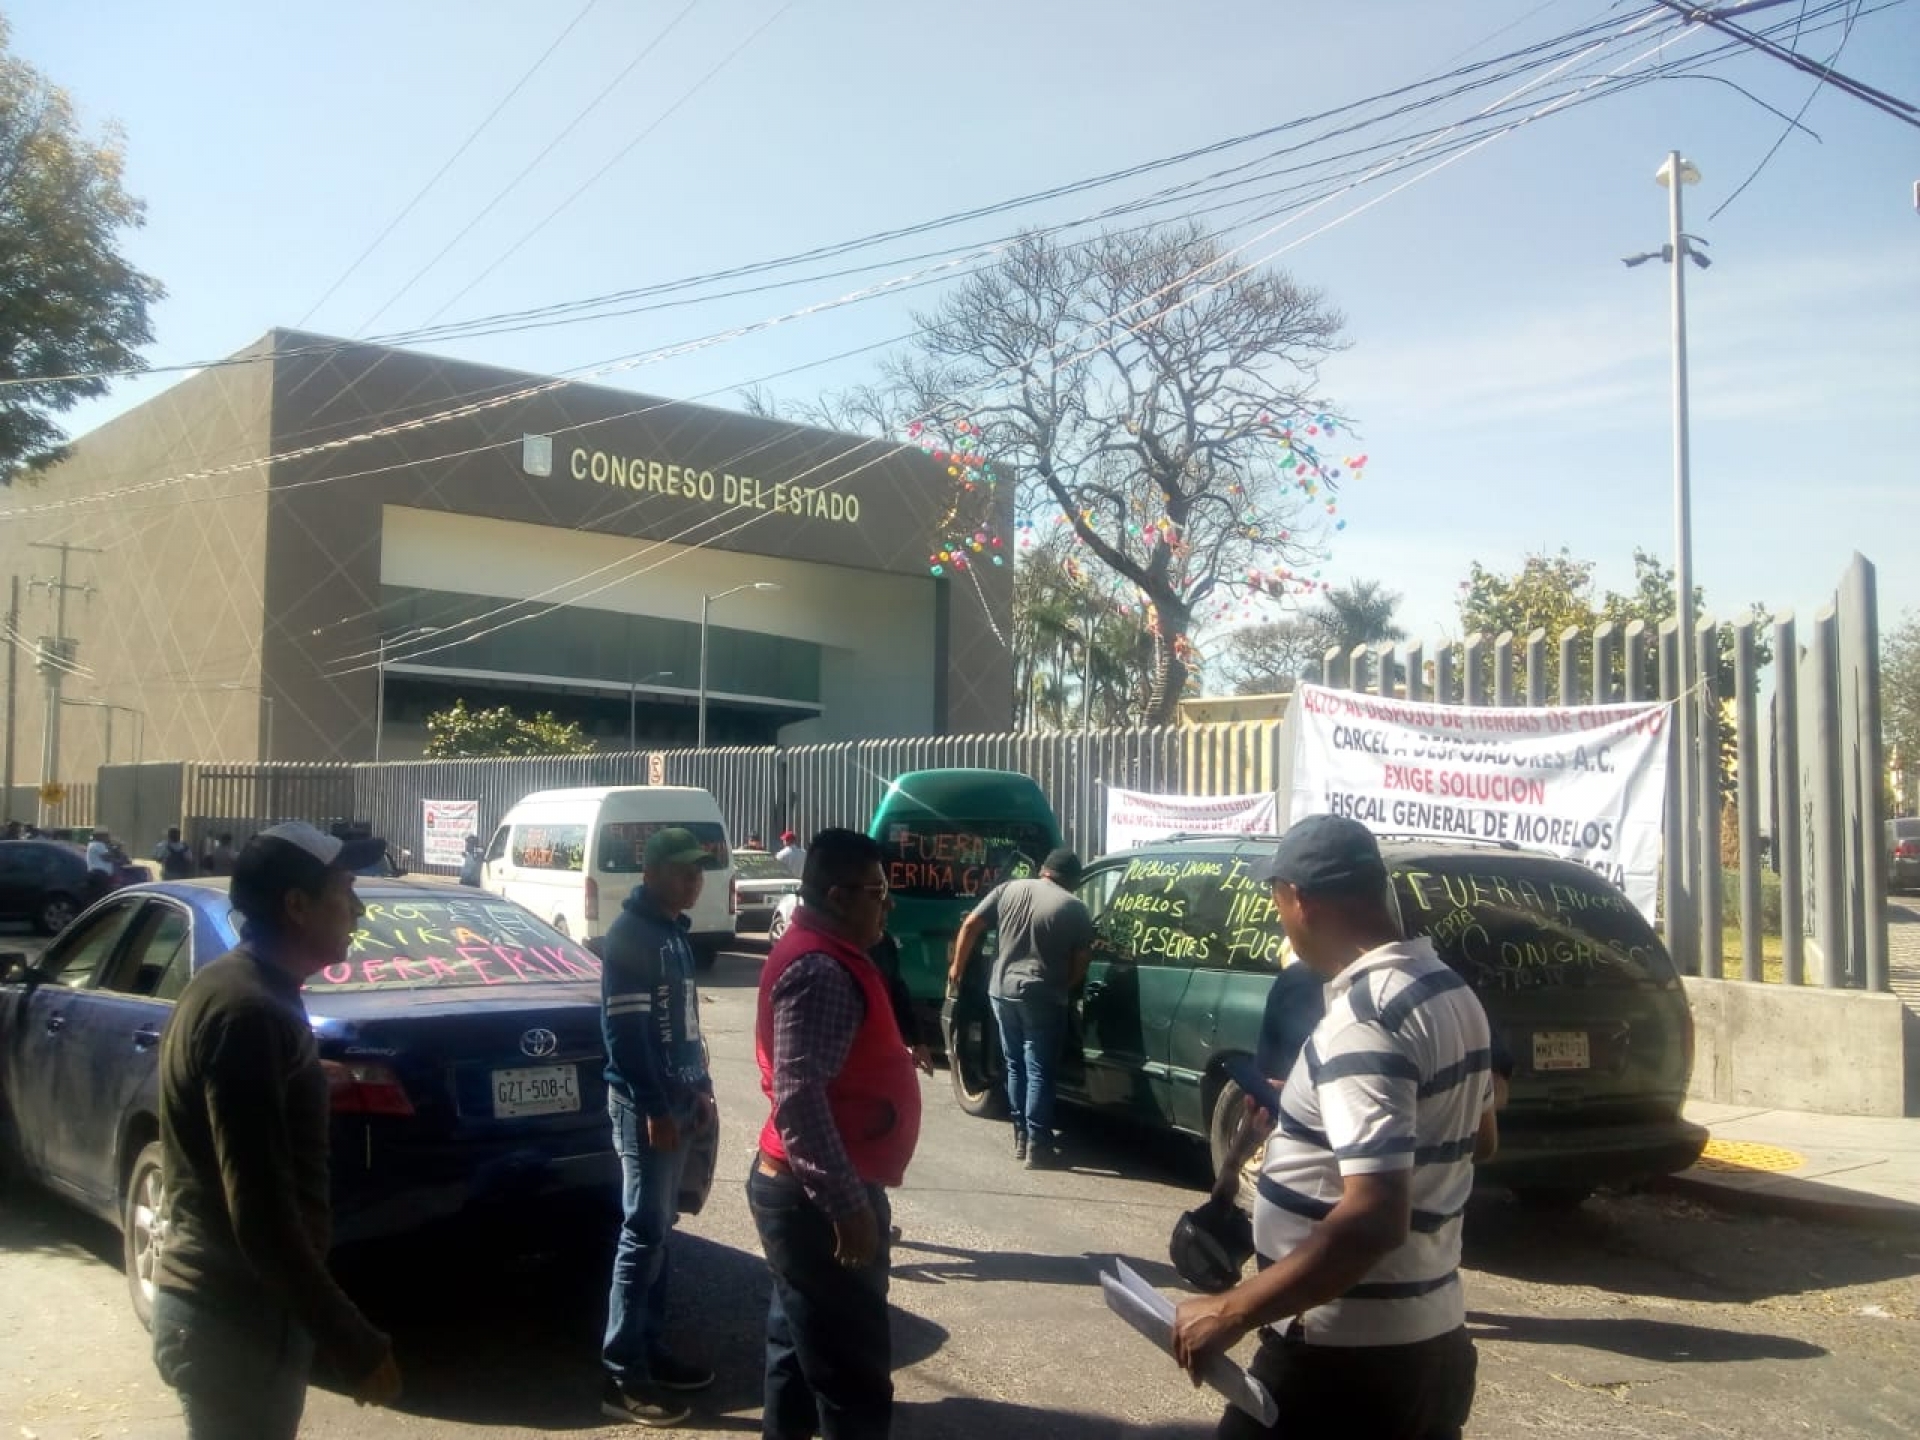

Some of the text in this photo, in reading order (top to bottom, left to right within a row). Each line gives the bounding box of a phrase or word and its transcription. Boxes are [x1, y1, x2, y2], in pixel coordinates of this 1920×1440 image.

[571, 447, 860, 523] CONGRESO DEL ESTADO
[1546, 709, 1572, 733] DE
[1333, 724, 1389, 756] CARCEL
[1574, 744, 1615, 773] A.C.
[1384, 764, 1545, 805] EXIGE SOLUCION
[1392, 800, 1476, 836] GENERAL
[1483, 811, 1508, 839] DE
[1514, 815, 1613, 851] MORELOS
[901, 831, 985, 860] FUERA
[890, 861, 954, 891] ERIKA
[1114, 892, 1186, 918] MORELOS
[350, 926, 490, 951] RIKA
[323, 955, 457, 984] UERA
[657, 984, 673, 1042] MILAN
